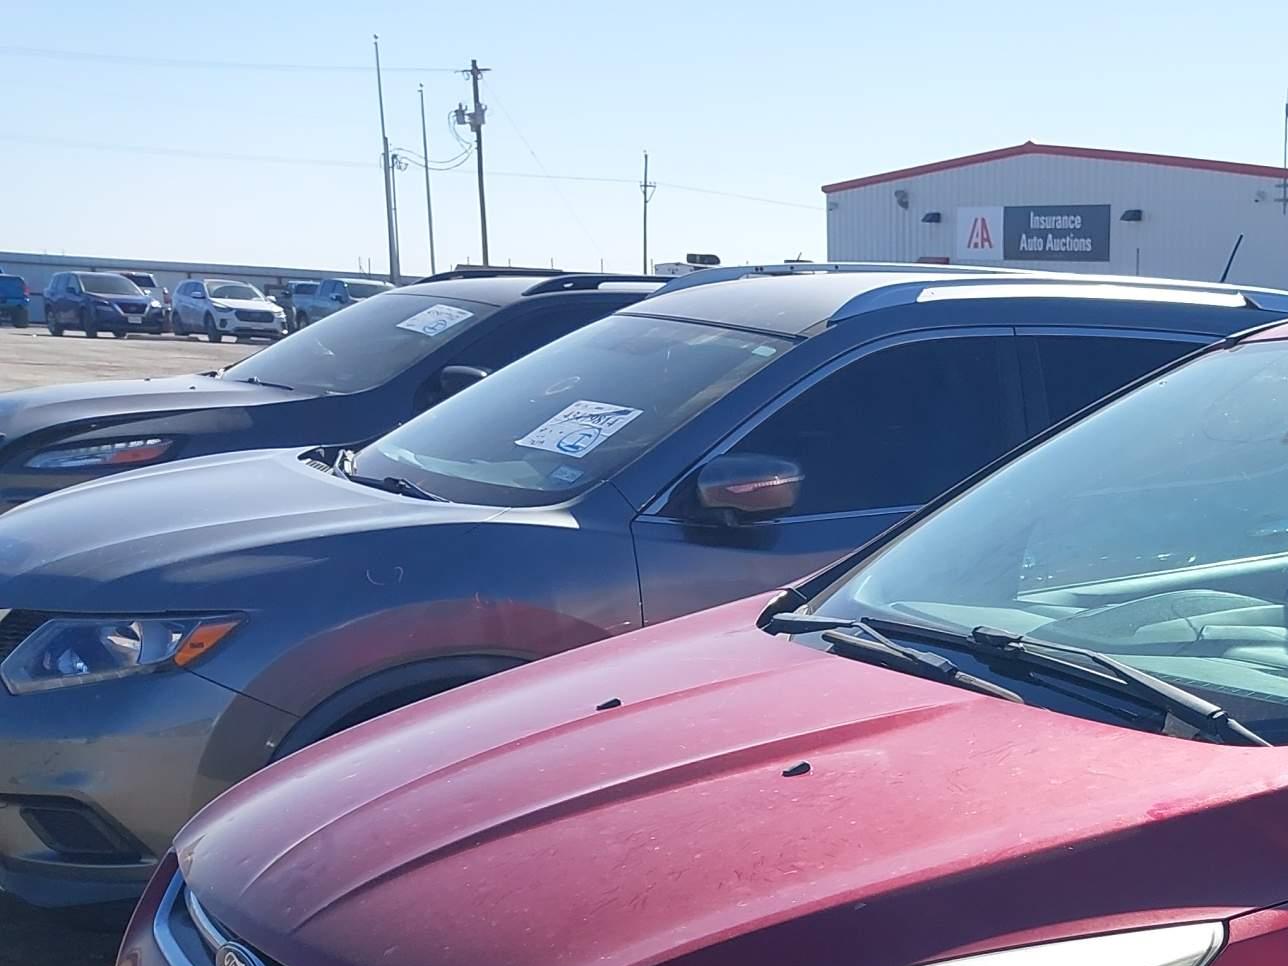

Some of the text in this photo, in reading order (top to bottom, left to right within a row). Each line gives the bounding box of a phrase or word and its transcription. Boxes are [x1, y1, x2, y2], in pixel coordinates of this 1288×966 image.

[1030, 211, 1082, 229] Insurance
[1019, 233, 1092, 251] Auto Auctions
